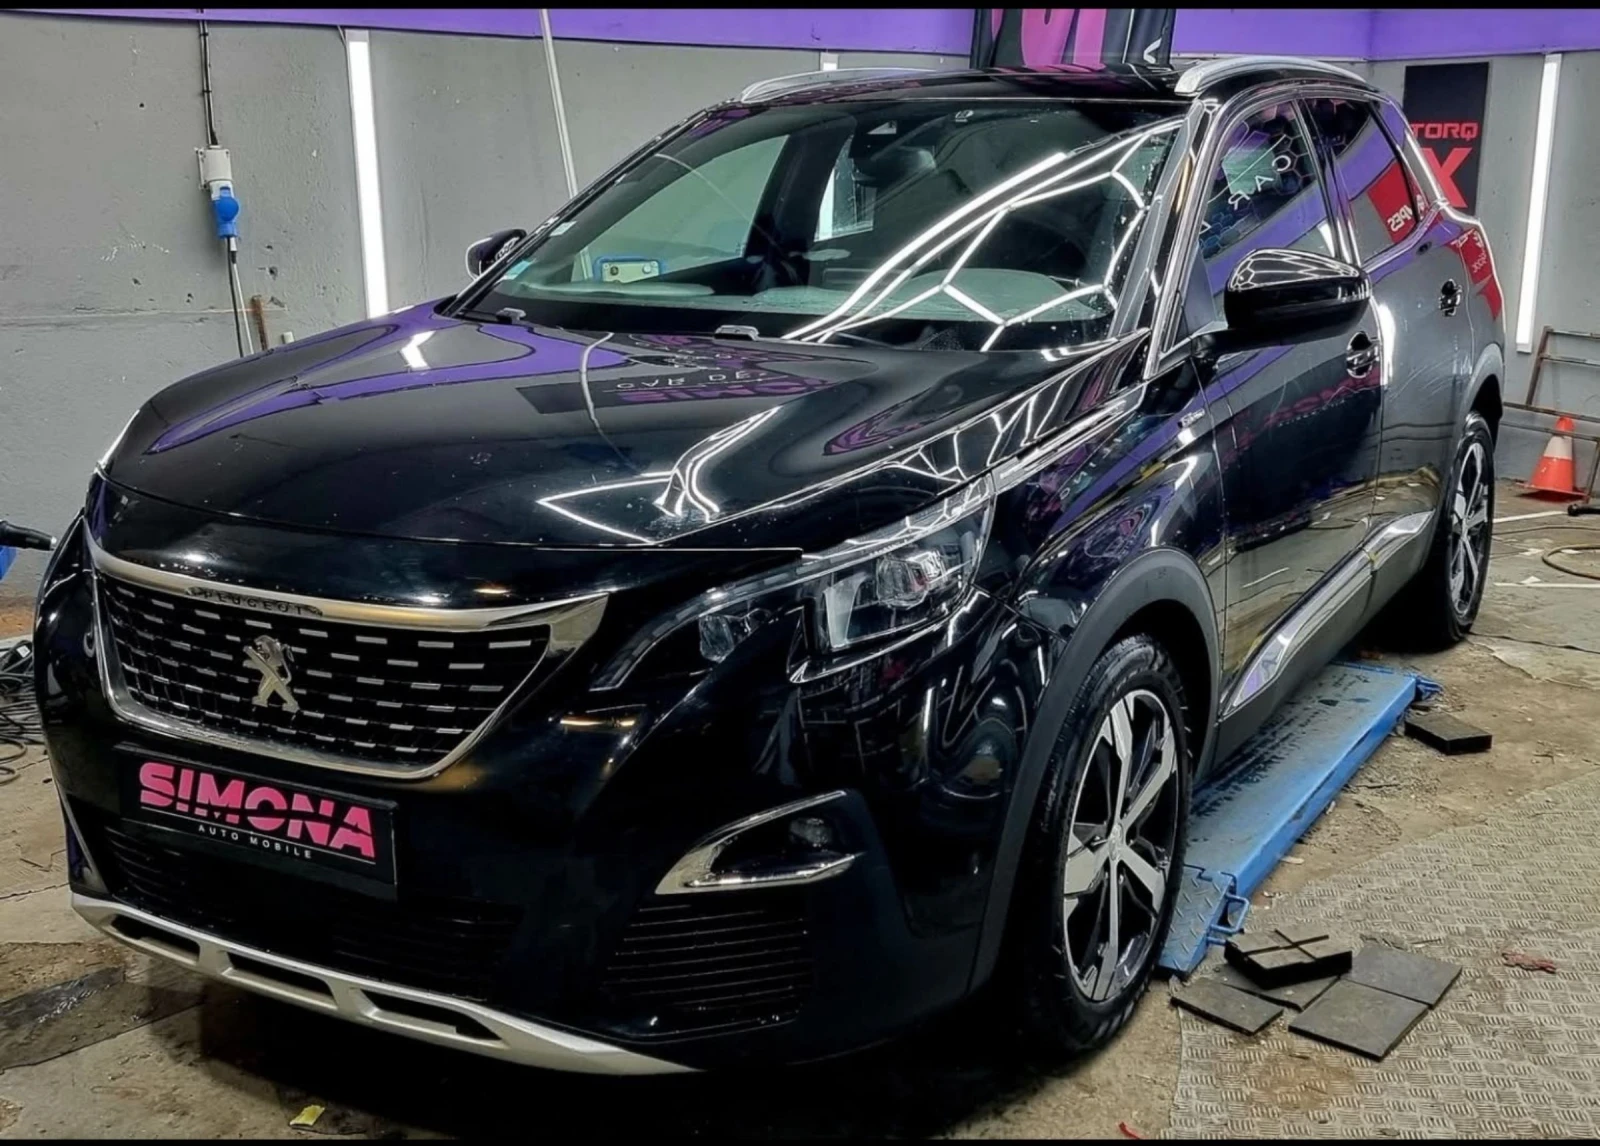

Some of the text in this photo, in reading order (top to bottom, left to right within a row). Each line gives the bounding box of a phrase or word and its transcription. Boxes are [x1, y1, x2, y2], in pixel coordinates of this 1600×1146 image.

[1409, 122, 1479, 141] TORQ
[203, 591, 304, 615] PEUGEOT
[139, 762, 376, 858] SIMONA
[198, 824, 312, 859] AUTO MOBILE
